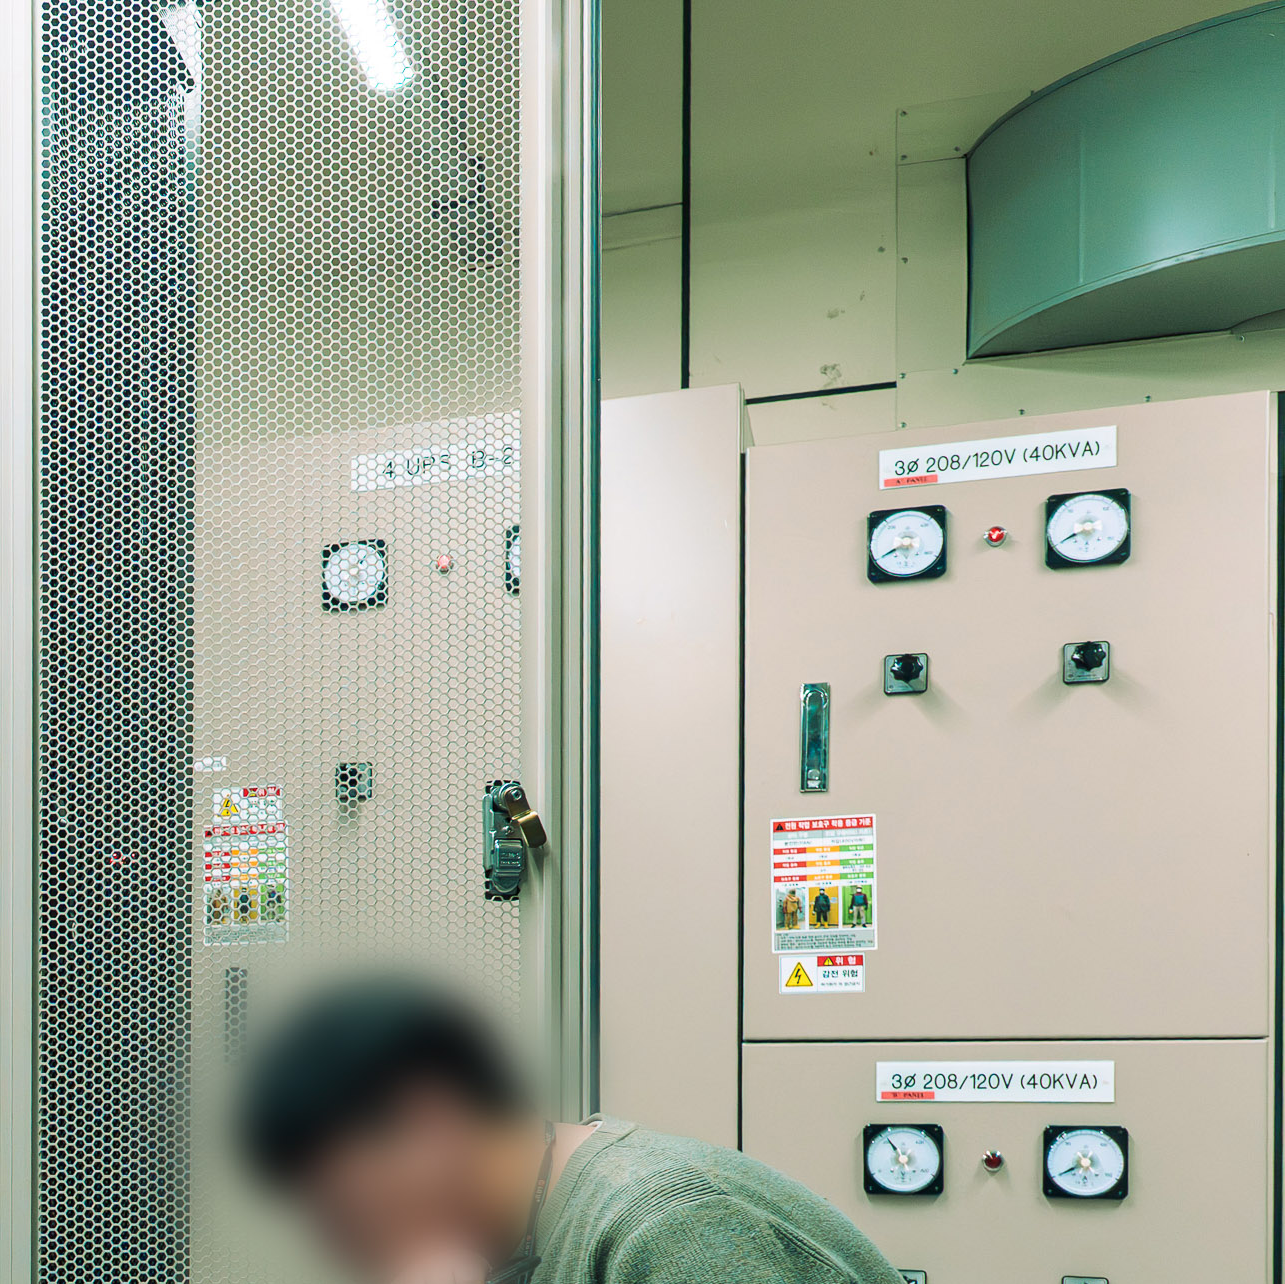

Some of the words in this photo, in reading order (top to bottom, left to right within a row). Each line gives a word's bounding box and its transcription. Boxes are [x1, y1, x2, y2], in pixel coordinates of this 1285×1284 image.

[407, 454, 451, 476] UPS
[926, 448, 1017, 473] 208/120V
[1022, 441, 1101, 463] (40KVA)
[842, 969, 858, 978] 위험
[923, 1073, 1014, 1090] 208/120V
[1020, 1073, 1099, 1090] (40KVA)
